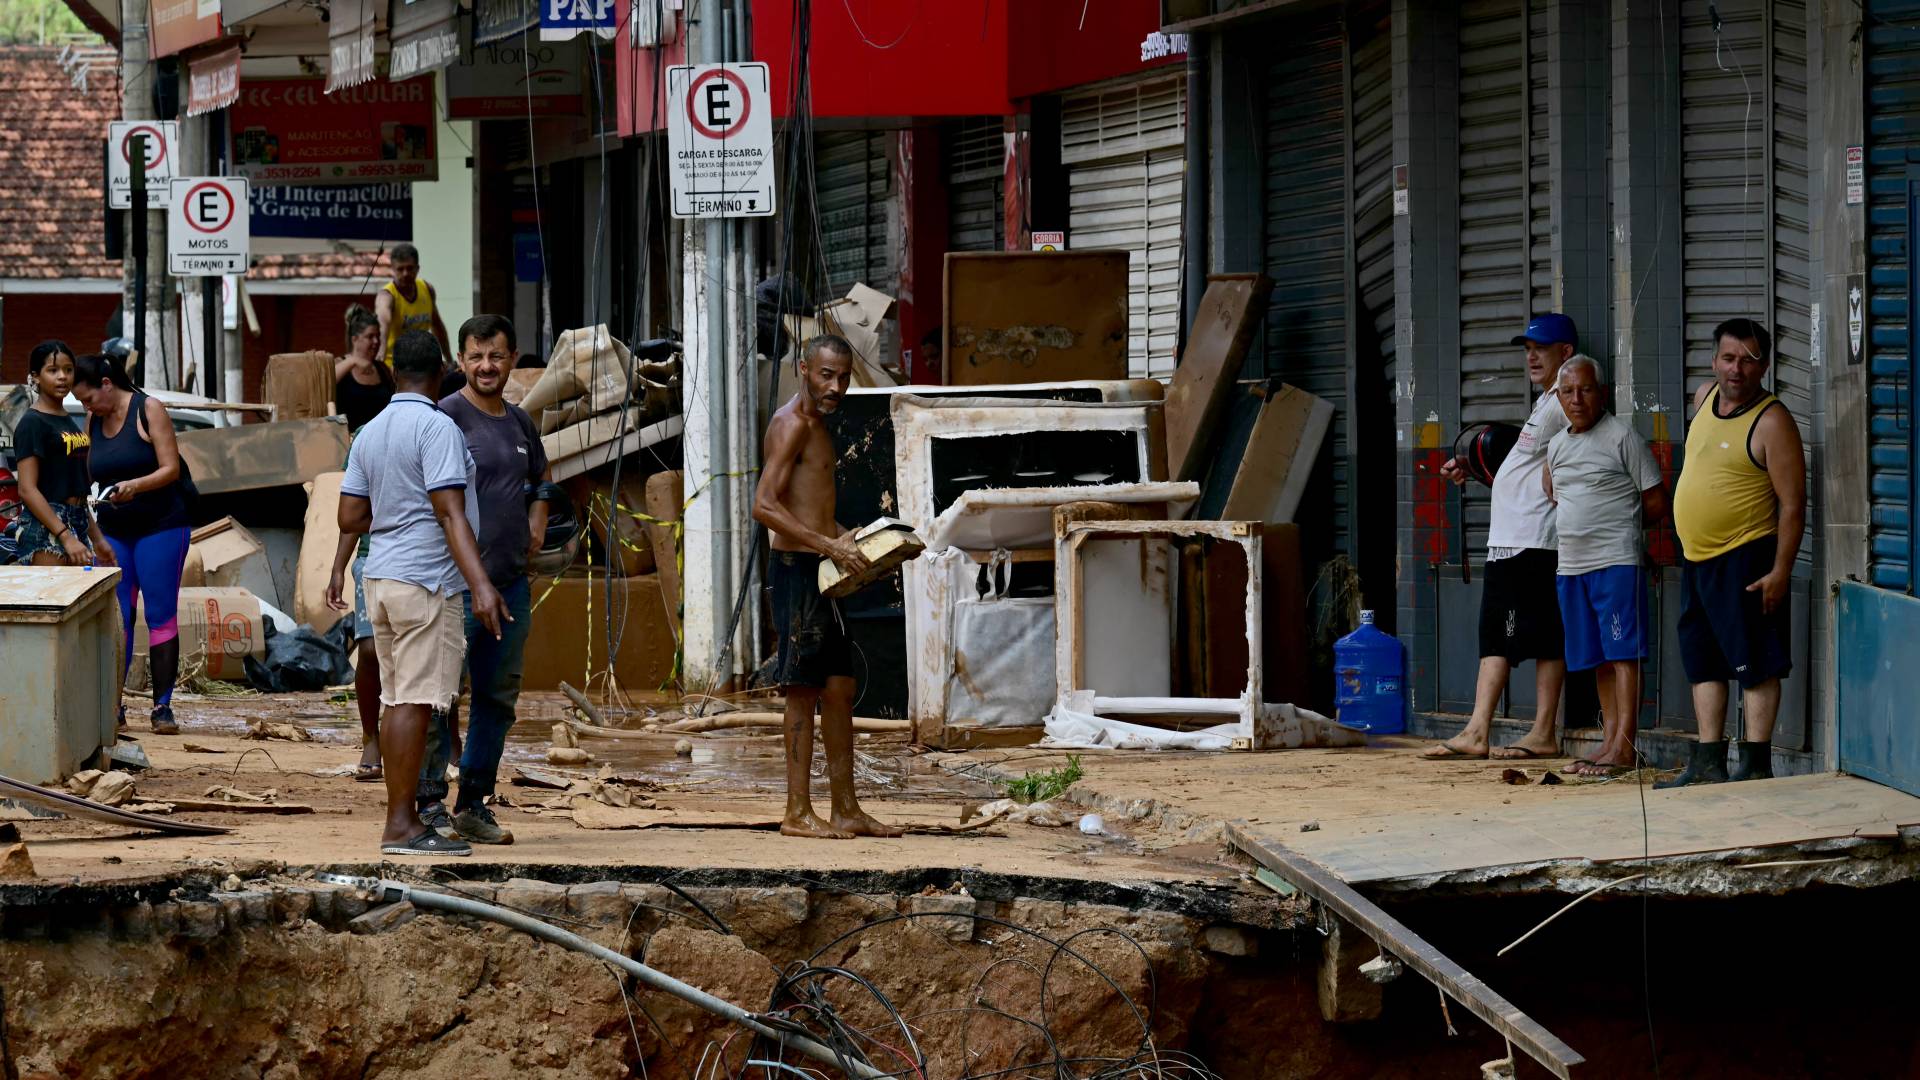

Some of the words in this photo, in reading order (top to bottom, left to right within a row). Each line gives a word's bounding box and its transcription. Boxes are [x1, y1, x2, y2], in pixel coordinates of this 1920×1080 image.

[707, 84, 731, 125] E
[678, 150, 707, 160] CARGA
[709, 150, 716, 158] E
[718, 148, 763, 158] DESCARGA
[200, 192, 218, 222] E
[261, 200, 321, 221] Graça
[327, 203, 351, 219] de
[356, 203, 405, 220] Deus
[188, 239, 229, 249] MOTOS
